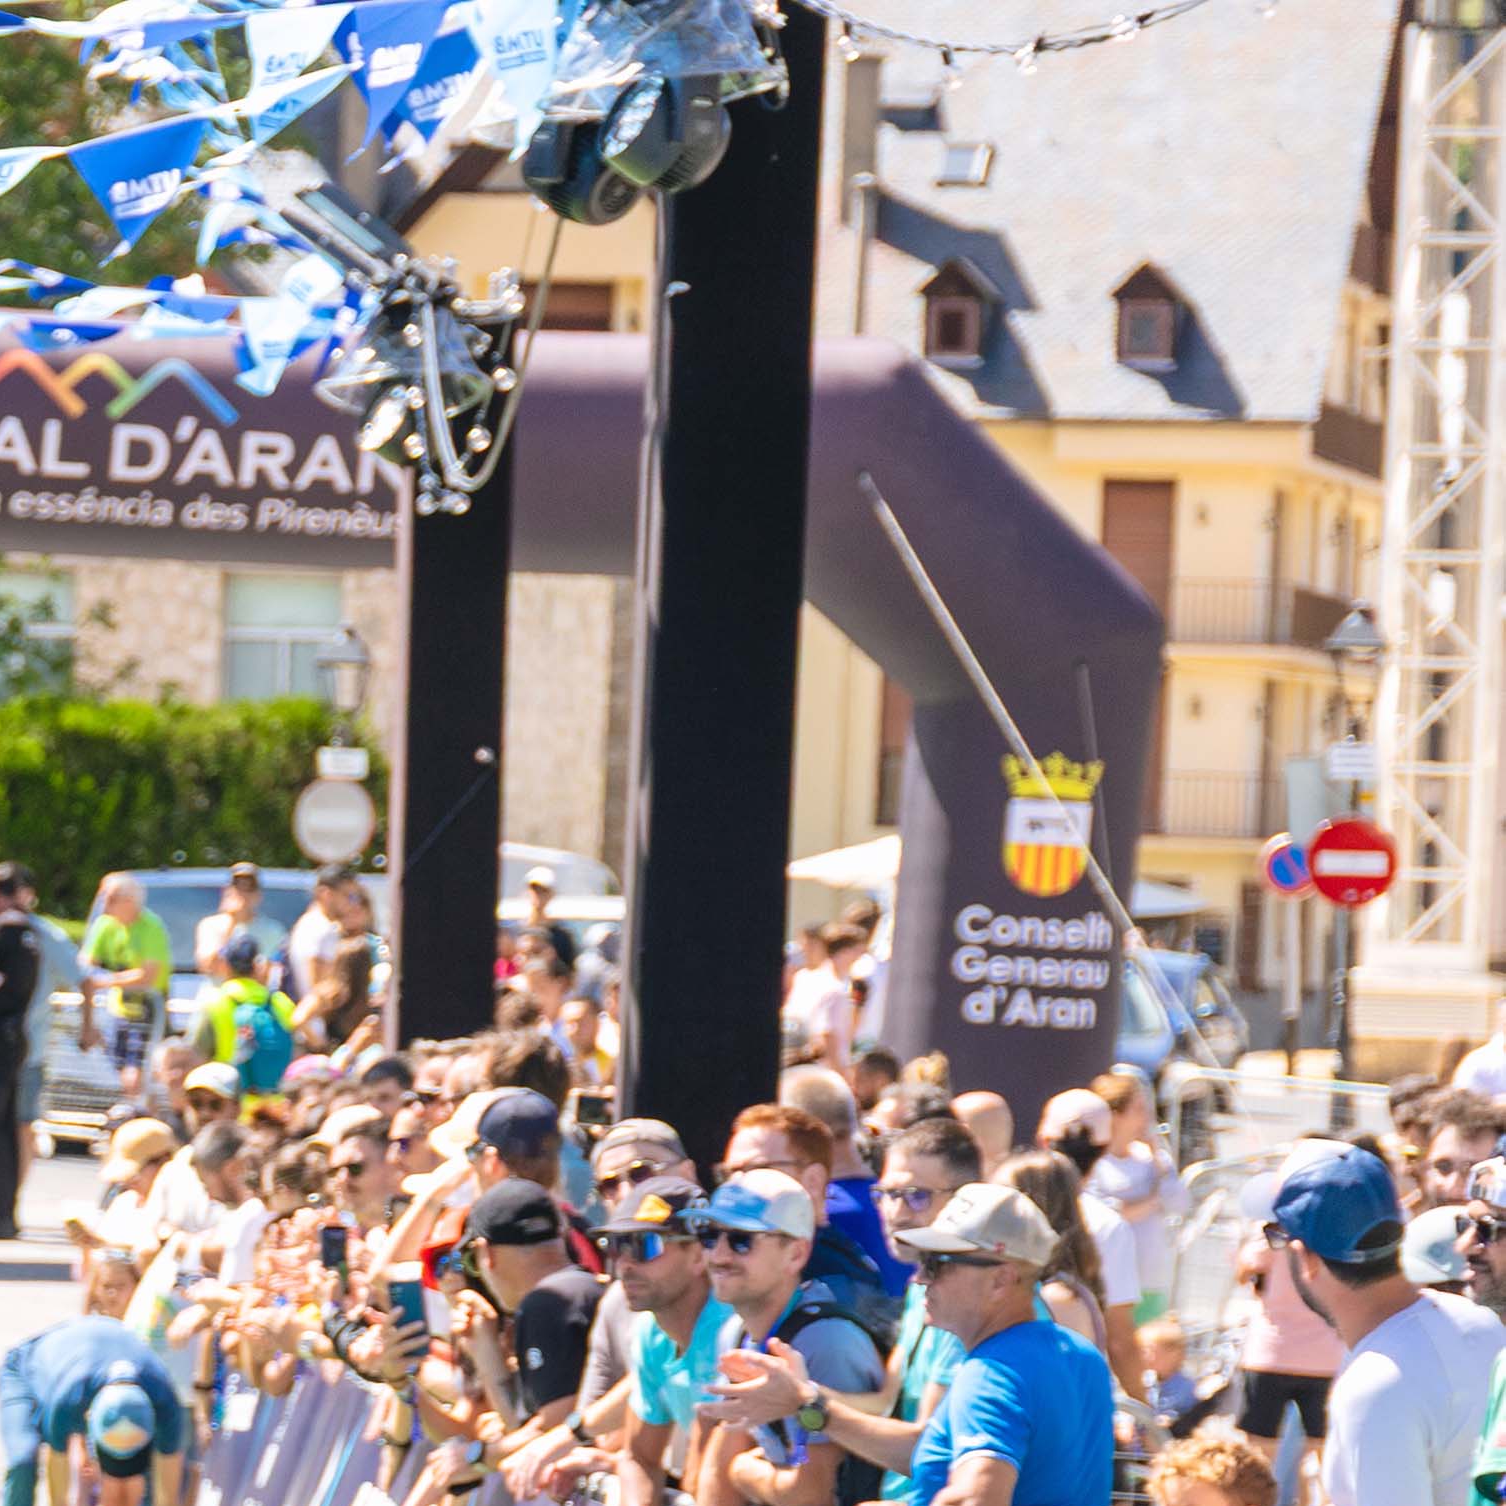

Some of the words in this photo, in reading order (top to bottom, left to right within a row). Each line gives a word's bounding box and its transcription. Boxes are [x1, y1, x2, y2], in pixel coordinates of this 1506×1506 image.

[180, 493, 249, 531] des
[954, 903, 1113, 953] Conselh
[950, 945, 1110, 991] Generau
[960, 985, 1098, 1031] d'Aran
